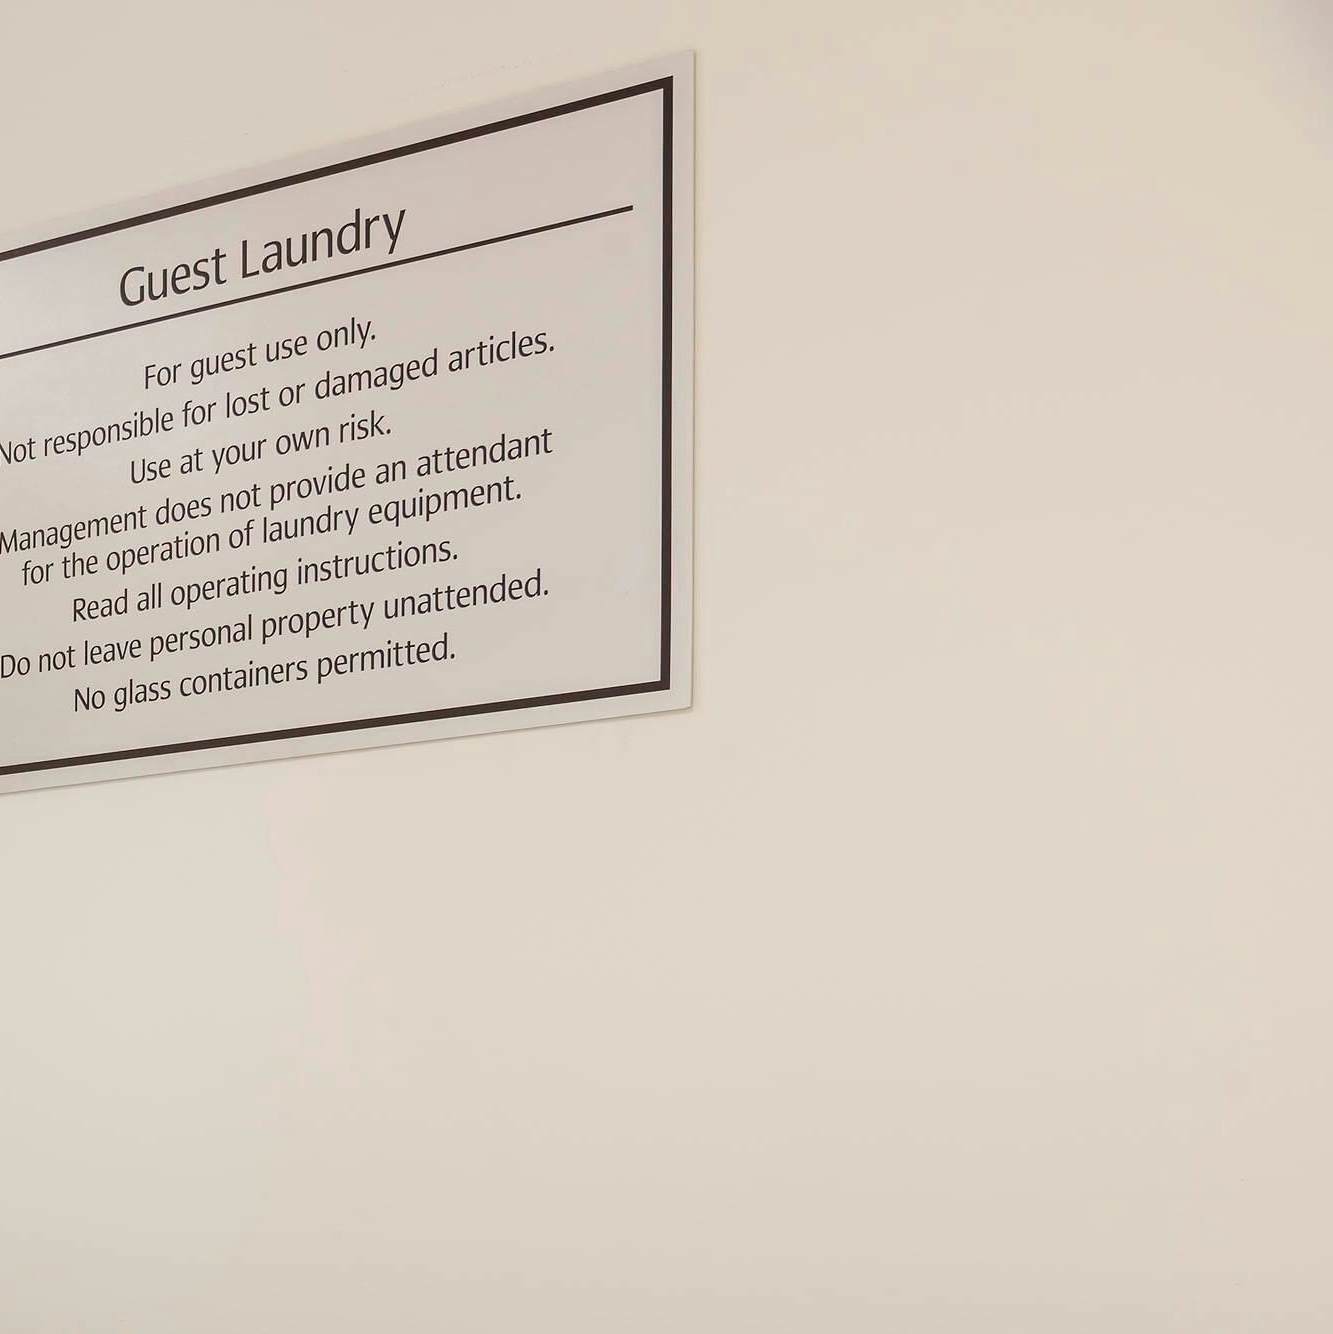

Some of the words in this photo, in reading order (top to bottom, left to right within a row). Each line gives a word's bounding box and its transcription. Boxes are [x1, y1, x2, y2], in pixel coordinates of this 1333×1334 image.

[119, 247, 228, 307] Guest
[241, 207, 407, 279] Laundry
[44, 407, 174, 457] responsible
[181, 399, 217, 428] for
[226, 387, 271, 419] lost
[278, 382, 306, 408] or
[314, 347, 438, 400] damaged
[448, 330, 555, 373] articles.
[144, 362, 182, 390] For
[190, 342, 258, 386] guest
[265, 335, 308, 363] use
[316, 316, 376, 352] only.
[130, 458, 172, 485] Use
[179, 447, 204, 475] at
[211, 438, 268, 475] your
[275, 426, 330, 456] own
[339, 409, 392, 444] risk.
[155, 496, 212, 526] does
[220, 483, 262, 514] not
[270, 462, 366, 512] provide
[375, 460, 407, 485] an
[416, 428, 554, 478] attendant
[21, 559, 55, 587] for
[61, 551, 99, 579] the
[106, 530, 220, 576] operation
[228, 518, 256, 550] of
[262, 504, 360, 544] laundry
[368, 475, 522, 528] equipment.
[0, 654, 31, 679] Do
[38, 645, 77, 673] not
[84, 638, 142, 666] leave
[150, 613, 253, 663] personal
[261, 600, 375, 646] property
[384, 567, 549, 620] unattended.
[73, 587, 128, 623] Read
[136, 581, 162, 612] all
[170, 565, 288, 611] operating
[297, 540, 458, 585] instructions.
[74, 686, 106, 713] No
[113, 678, 172, 713] glass
[179, 659, 308, 697] containers
[317, 631, 456, 685] permitted.
